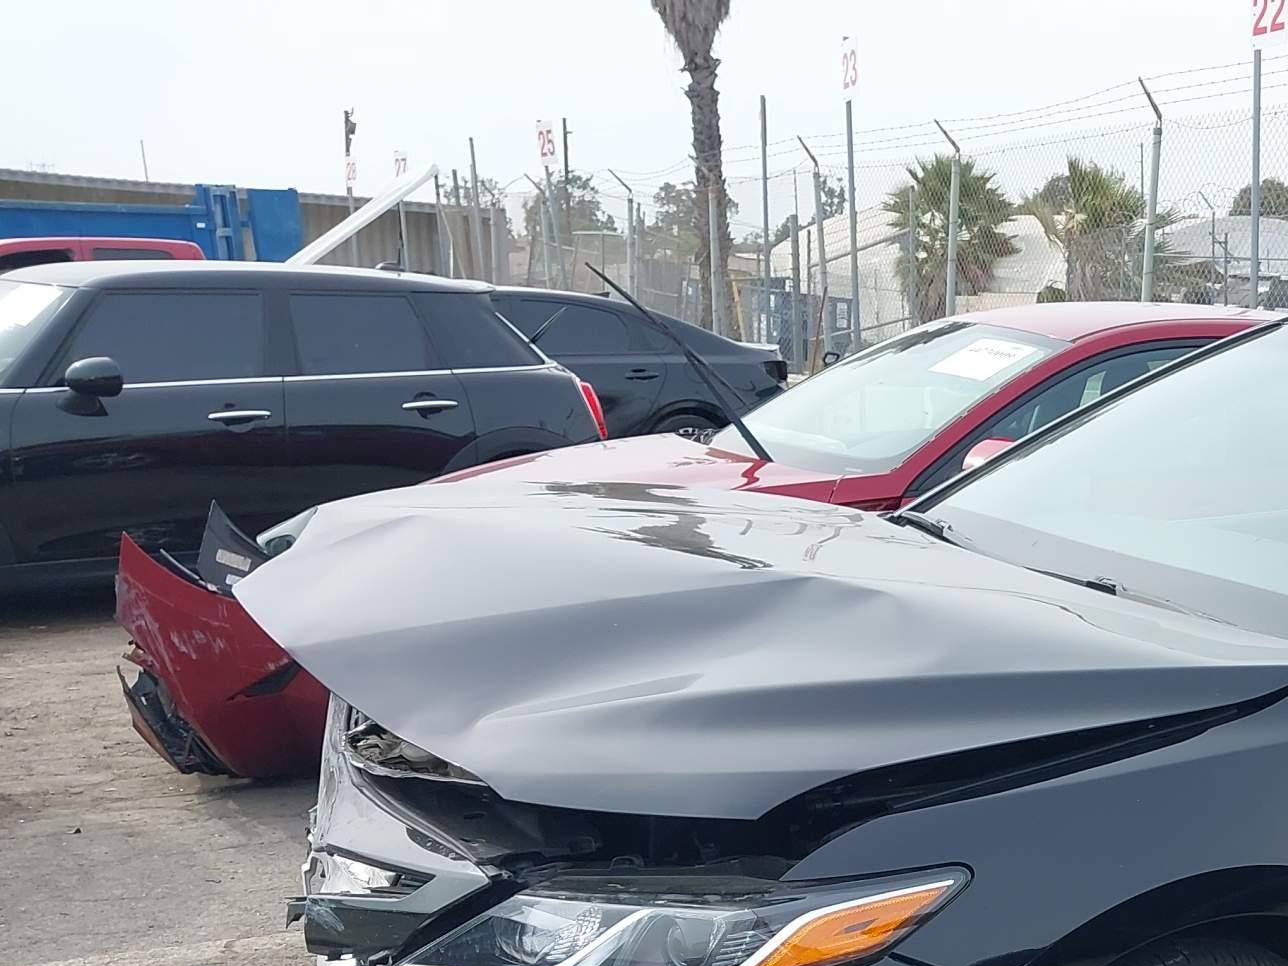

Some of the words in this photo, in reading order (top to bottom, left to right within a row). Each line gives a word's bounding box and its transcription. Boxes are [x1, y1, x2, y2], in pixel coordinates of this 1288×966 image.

[1253, 0, 1285, 36] 22
[842, 49, 857, 89] 23
[538, 129, 555, 157] 25
